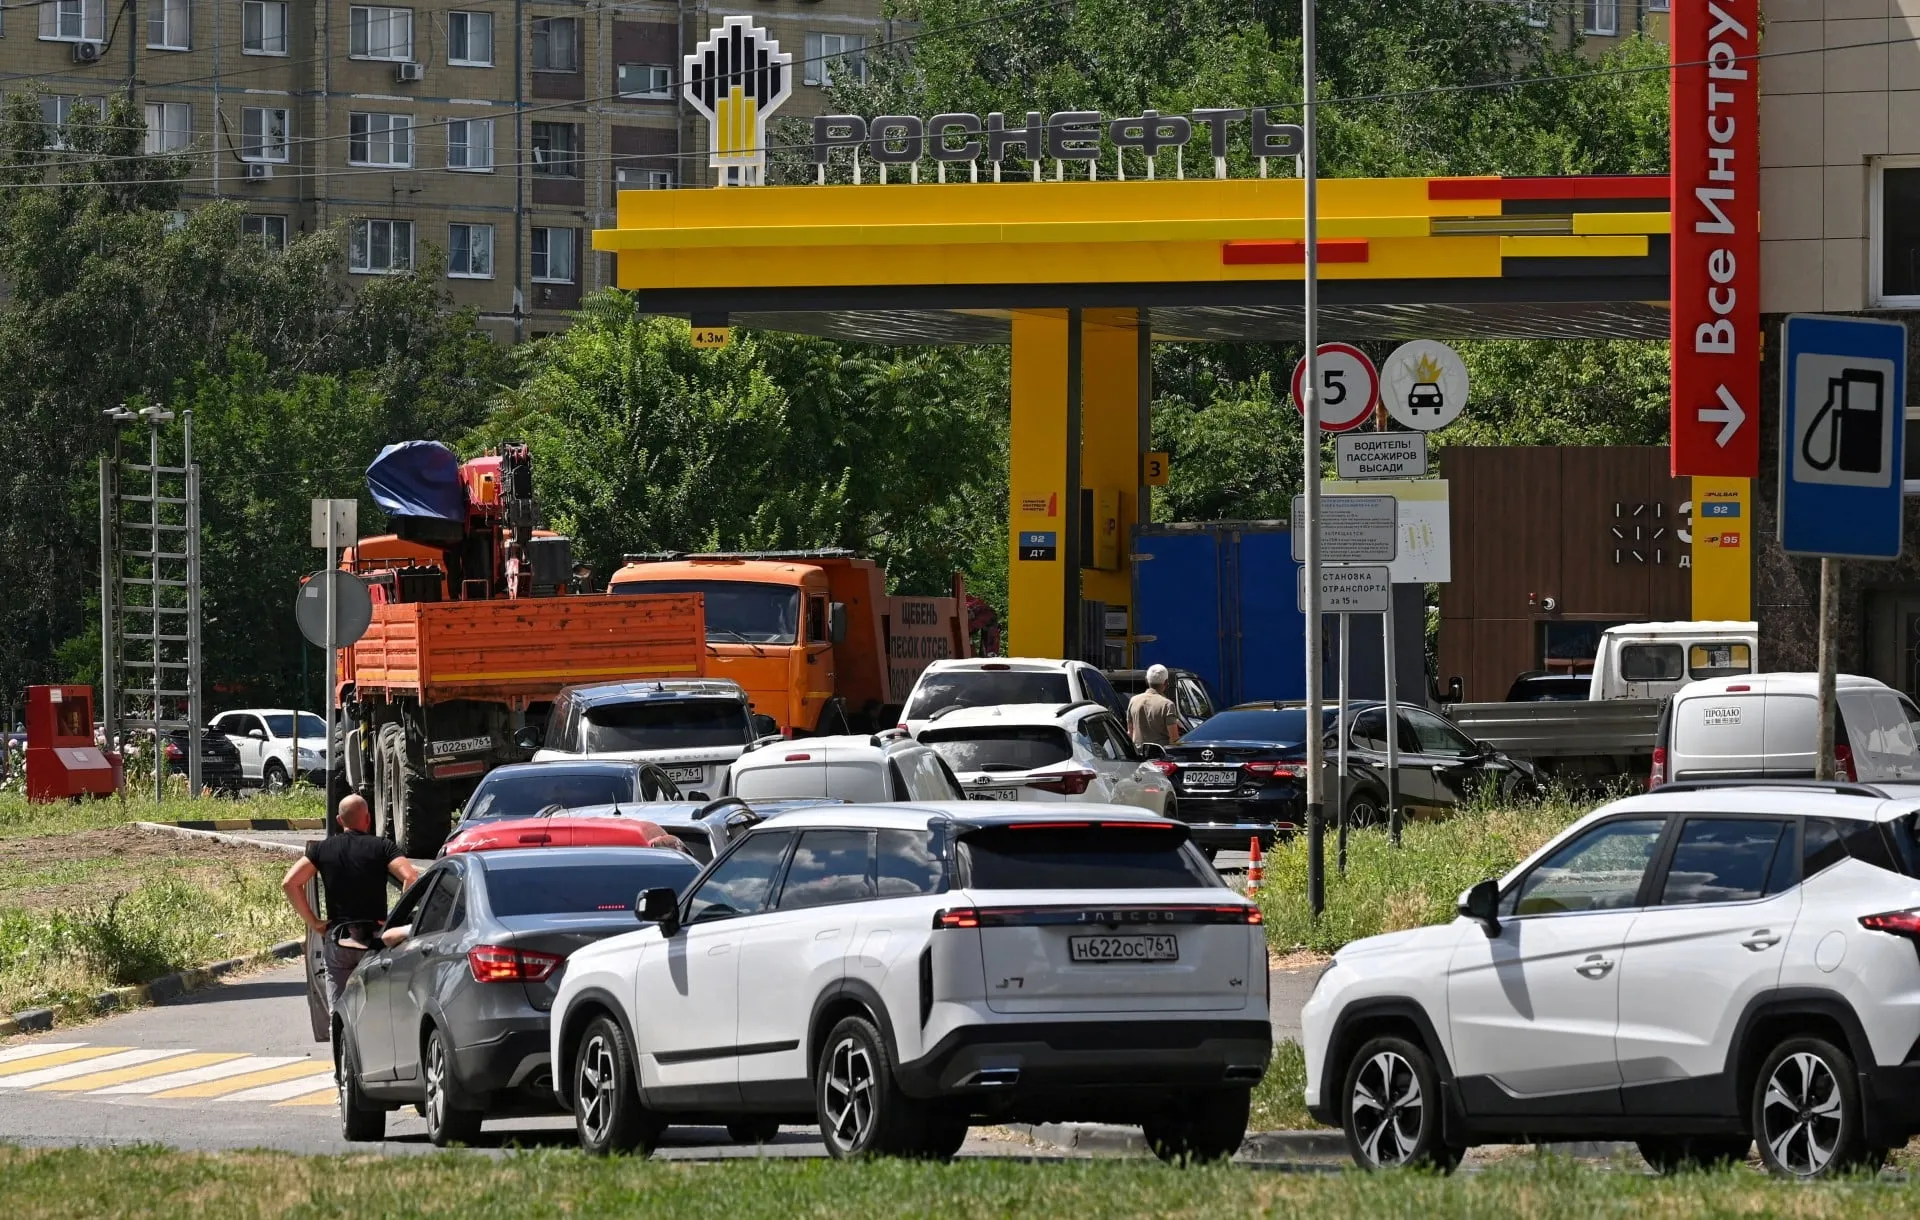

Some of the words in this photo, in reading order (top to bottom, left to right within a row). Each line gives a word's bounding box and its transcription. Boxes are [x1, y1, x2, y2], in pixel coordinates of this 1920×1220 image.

[1695, 0, 1748, 234] Инстру
[813, 109, 1305, 164] РОСНЕФТЬ
[1695, 248, 1736, 354] Все
[696, 332, 724, 343] 4.3м
[1324, 370, 1348, 405] 5
[1354, 440, 1411, 451] ВОДИТЕЛЬ!
[1346, 451, 1417, 462] ПАССАЖИРОВ
[1149, 461, 1161, 477] 3
[1359, 463, 1404, 473] ВЫСАДИ
[1713, 505, 1729, 514] 92
[1030, 535, 1046, 543] 92
[1723, 536, 1739, 544] 95
[1029, 549, 1046, 557] ДТ
[1322, 573, 1372, 581] СТАНОВКА
[1303, 585, 1387, 593] ОТРАНСПОРТА
[902, 603, 937, 628] ЩЕБЕНЬ
[889, 636, 919, 659] ПЕСОК
[921, 637, 949, 660] ОТСЕВ
[1705, 709, 1740, 717] ПРОДАЮ
[684, 768, 699, 777] 761
[1186, 772, 1220, 782] В022ОВ
[1222, 772, 1235, 780] 761
[998, 791, 1014, 800] 761
[1077, 939, 1145, 958] Н622ОС
[1146, 937, 1173, 952] 761
